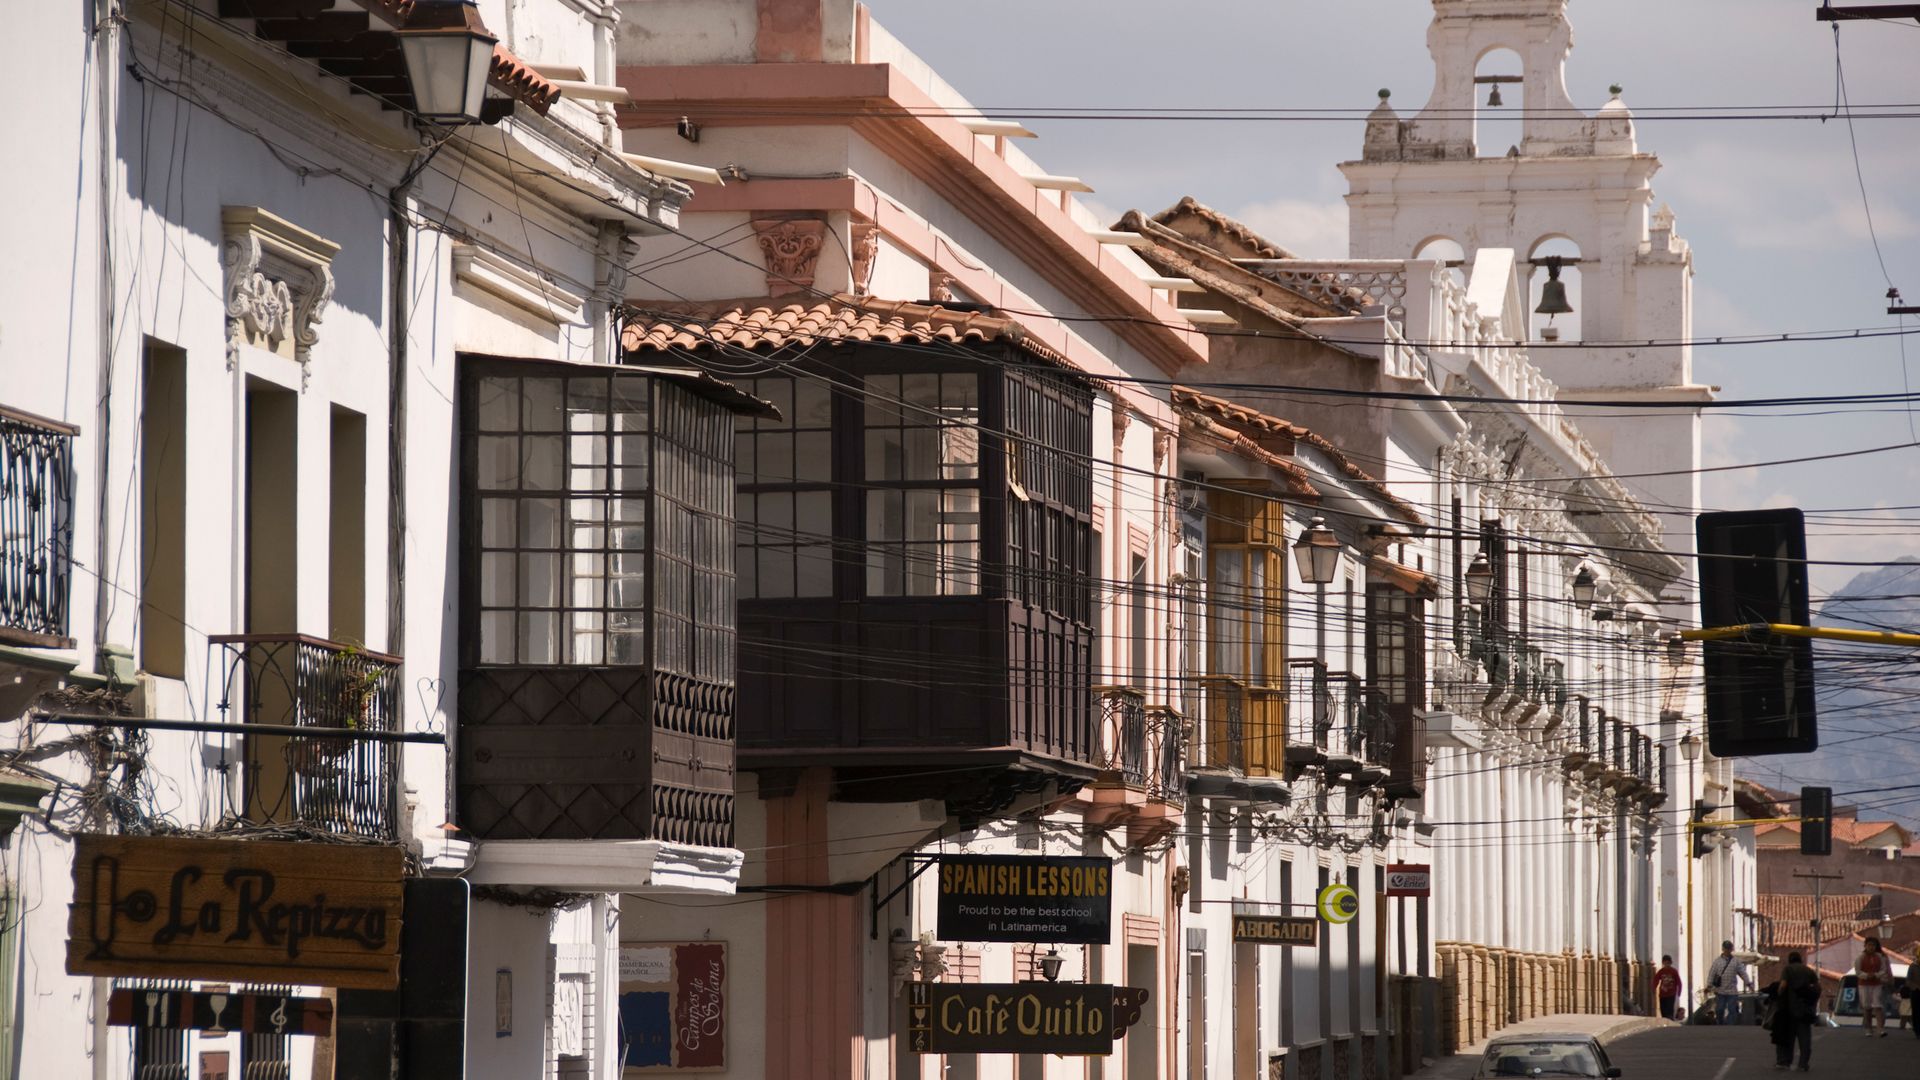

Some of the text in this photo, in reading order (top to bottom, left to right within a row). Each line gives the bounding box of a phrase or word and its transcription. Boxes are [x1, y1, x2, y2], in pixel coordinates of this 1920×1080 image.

[942, 863, 1109, 898] SPANISH LESSONS
[153, 865, 389, 960] La Repizza
[958, 904, 1092, 918] Proud to be the best school
[988, 921, 1067, 933] in Latinamerica
[1236, 920, 1314, 940] ABOGADO
[689, 977, 705, 994] de
[701, 959, 721, 1036] Solana
[1846, 989, 1853, 1000] 5
[680, 990, 704, 1051] Campos
[940, 992, 1104, 1036] Café Quito
